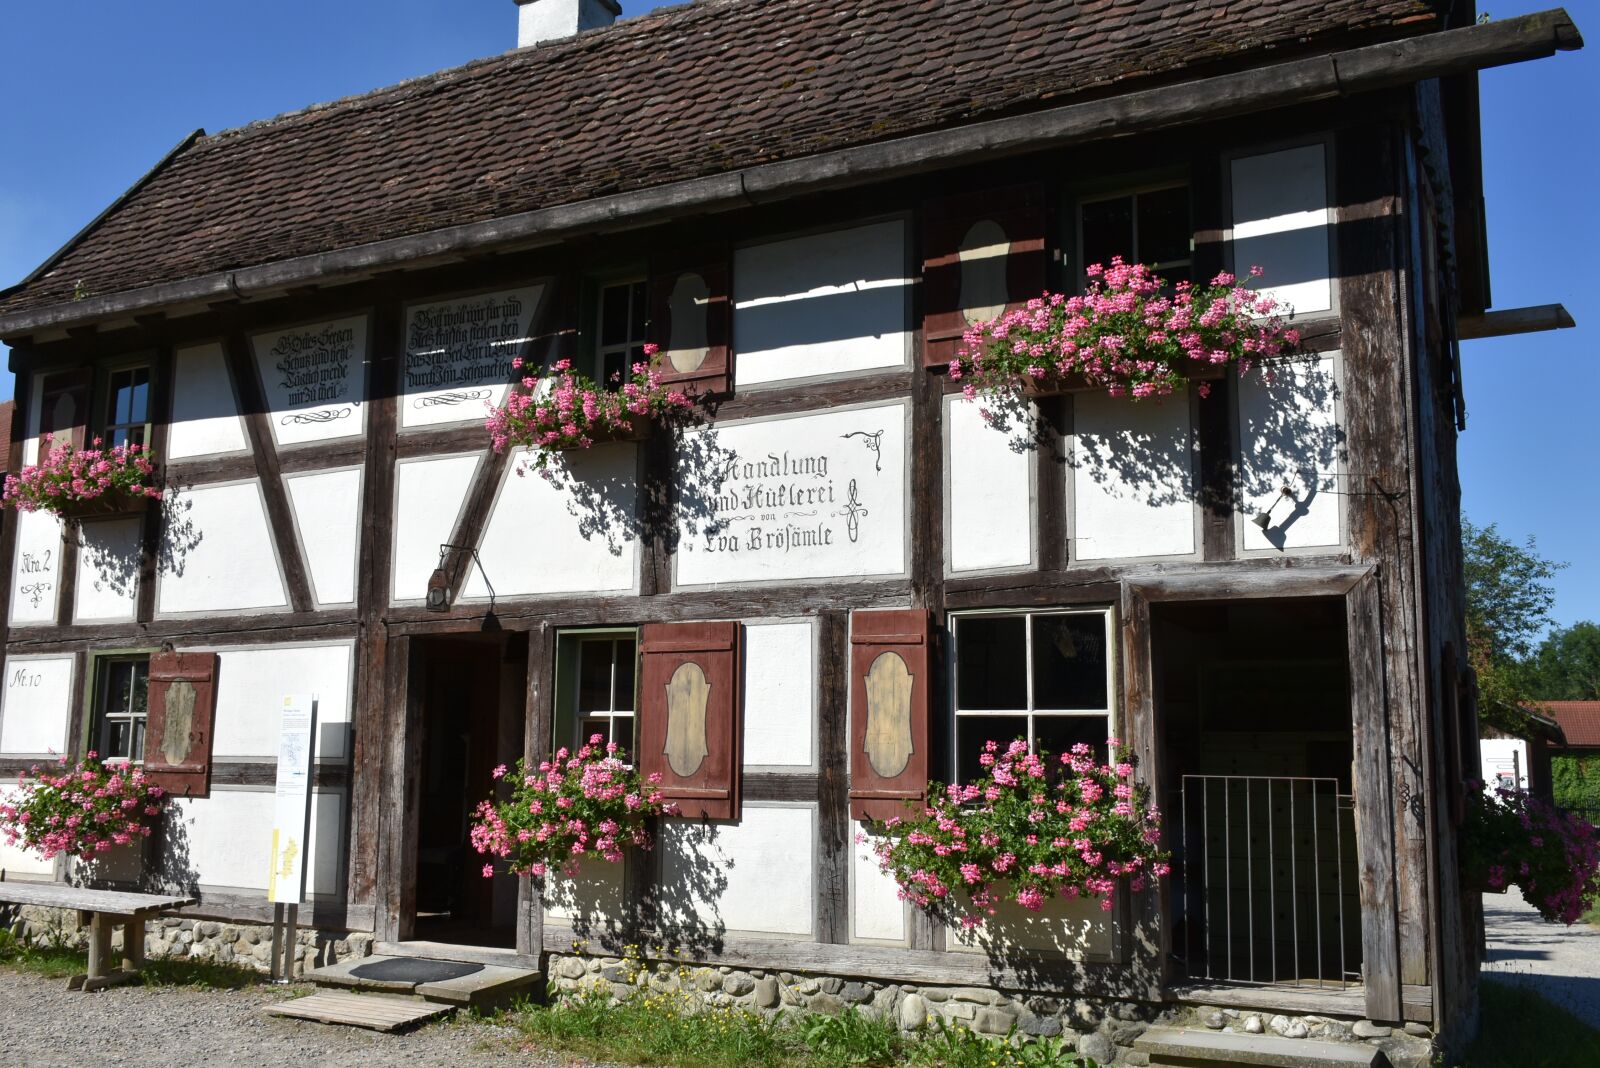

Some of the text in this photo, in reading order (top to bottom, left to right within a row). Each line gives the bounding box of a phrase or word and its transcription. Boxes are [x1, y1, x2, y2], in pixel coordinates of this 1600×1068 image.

[722, 450, 828, 482] Handlung
[708, 488, 738, 512] und
[761, 513, 777, 521] von
[703, 529, 739, 552] Eva
